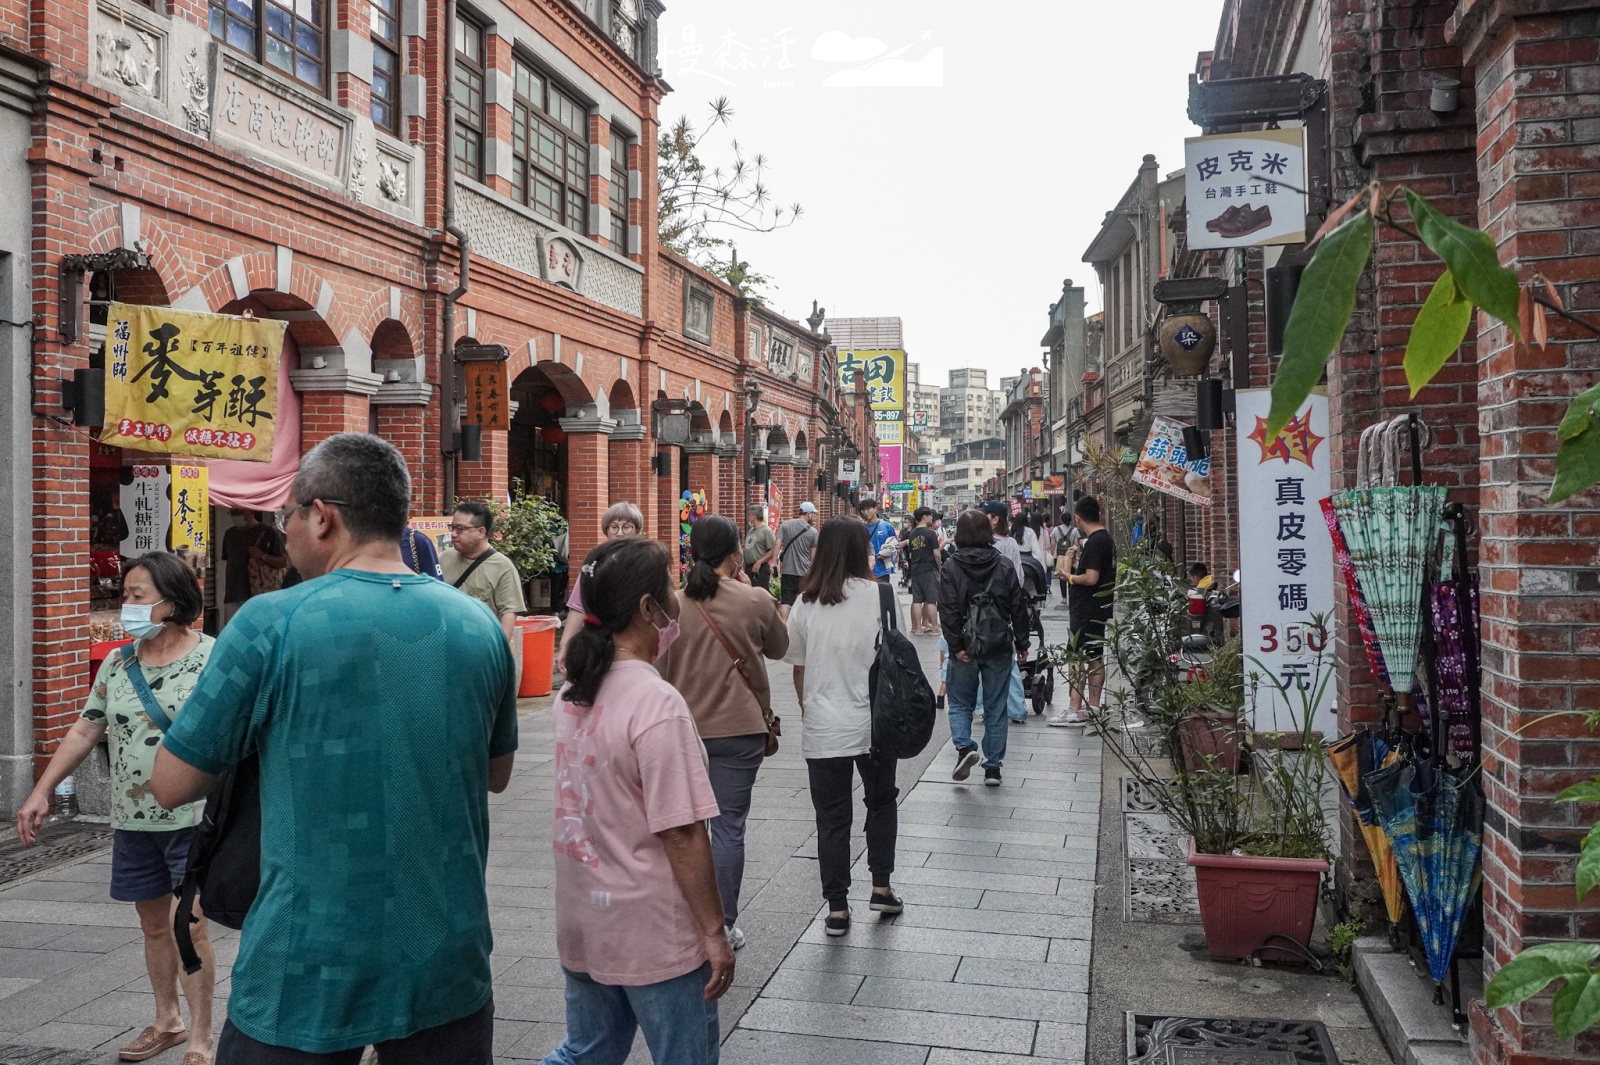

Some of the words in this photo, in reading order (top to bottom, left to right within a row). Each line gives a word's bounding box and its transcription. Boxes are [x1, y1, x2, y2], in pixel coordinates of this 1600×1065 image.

[1196, 150, 1289, 182] 皮克米
[1205, 182, 1278, 200] 台灣手工鞋
[112, 321, 131, 382] 福州師
[130, 323, 273, 428] 麥芽酥
[838, 352, 895, 384] 吉田
[1275, 476, 1308, 612] 真皮零碼
[1279, 663, 1310, 692] 元
